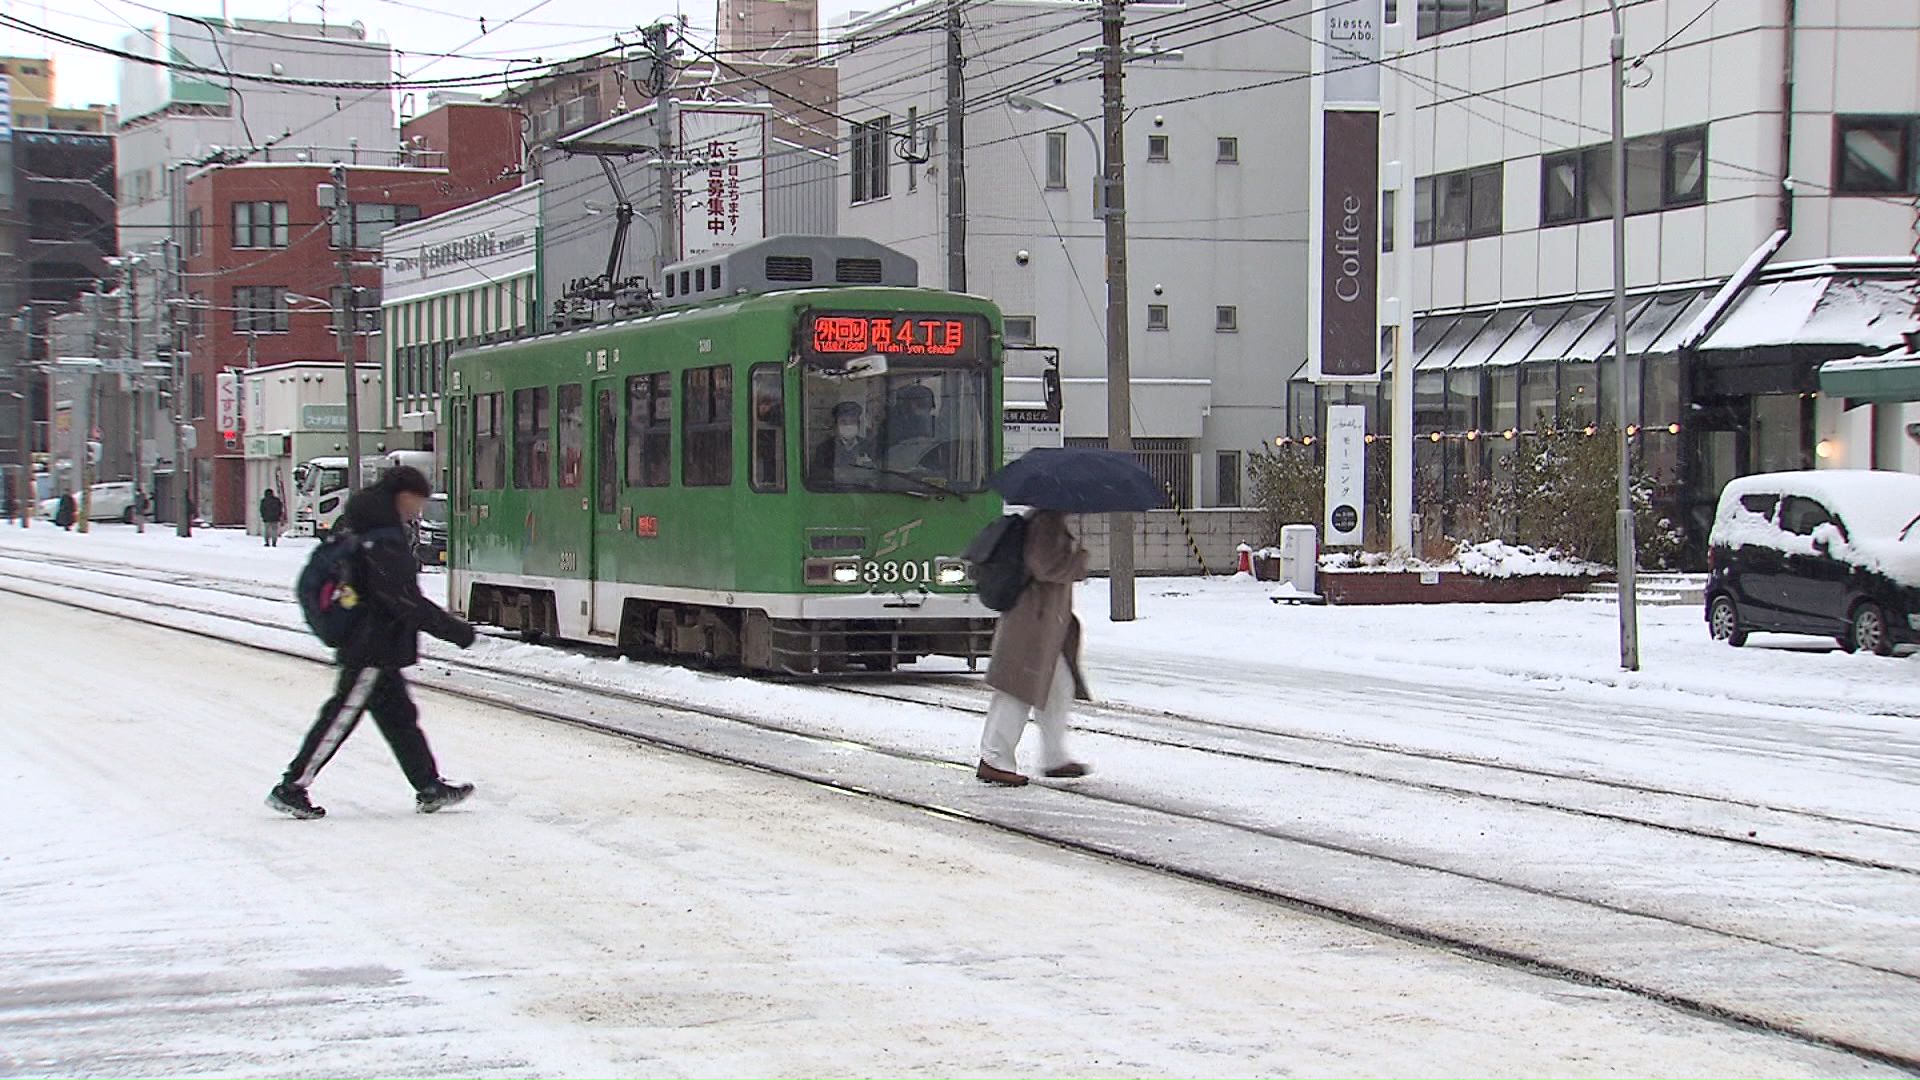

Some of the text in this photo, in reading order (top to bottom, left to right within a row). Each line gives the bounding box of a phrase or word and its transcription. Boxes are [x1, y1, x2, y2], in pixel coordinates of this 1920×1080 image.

[1335, 195, 1361, 303] Coffee
[871, 318, 964, 347] 西4丁目
[220, 381, 235, 429] くすり
[1340, 436, 1350, 497] モーニング
[863, 560, 932, 583] 3301
